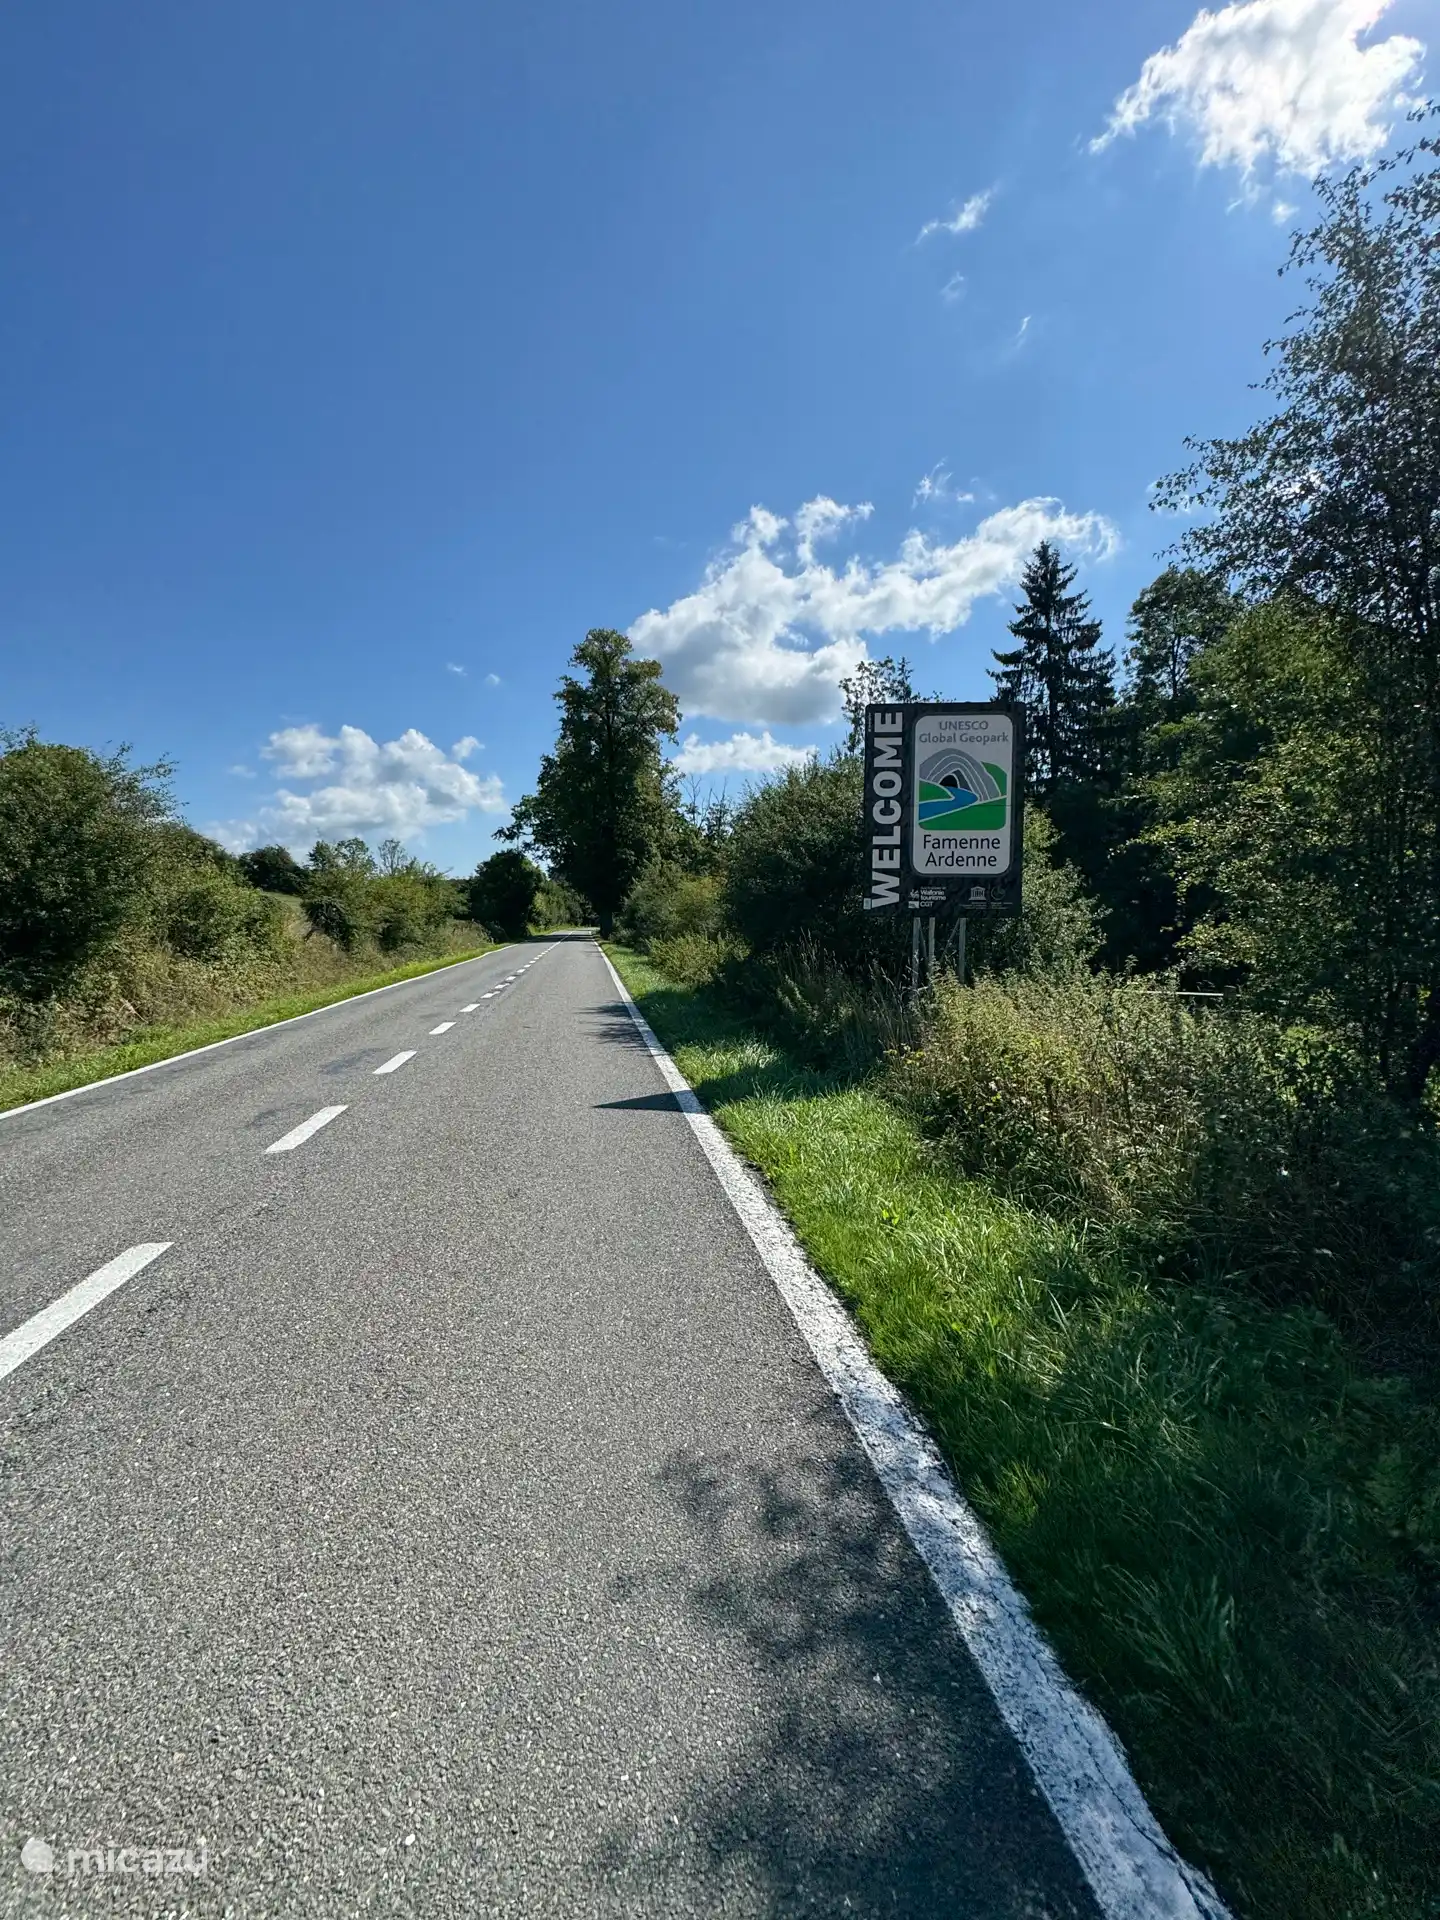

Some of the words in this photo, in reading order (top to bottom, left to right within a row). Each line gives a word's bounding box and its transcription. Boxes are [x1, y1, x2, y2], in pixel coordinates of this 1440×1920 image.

[939, 720, 989, 731] UNESCO
[919, 732, 956, 743] Global
[959, 733, 1009, 745] Geopark
[871, 711, 903, 910] WELCOME
[923, 834, 1001, 850] Famenne
[925, 852, 997, 867] Ardenne
